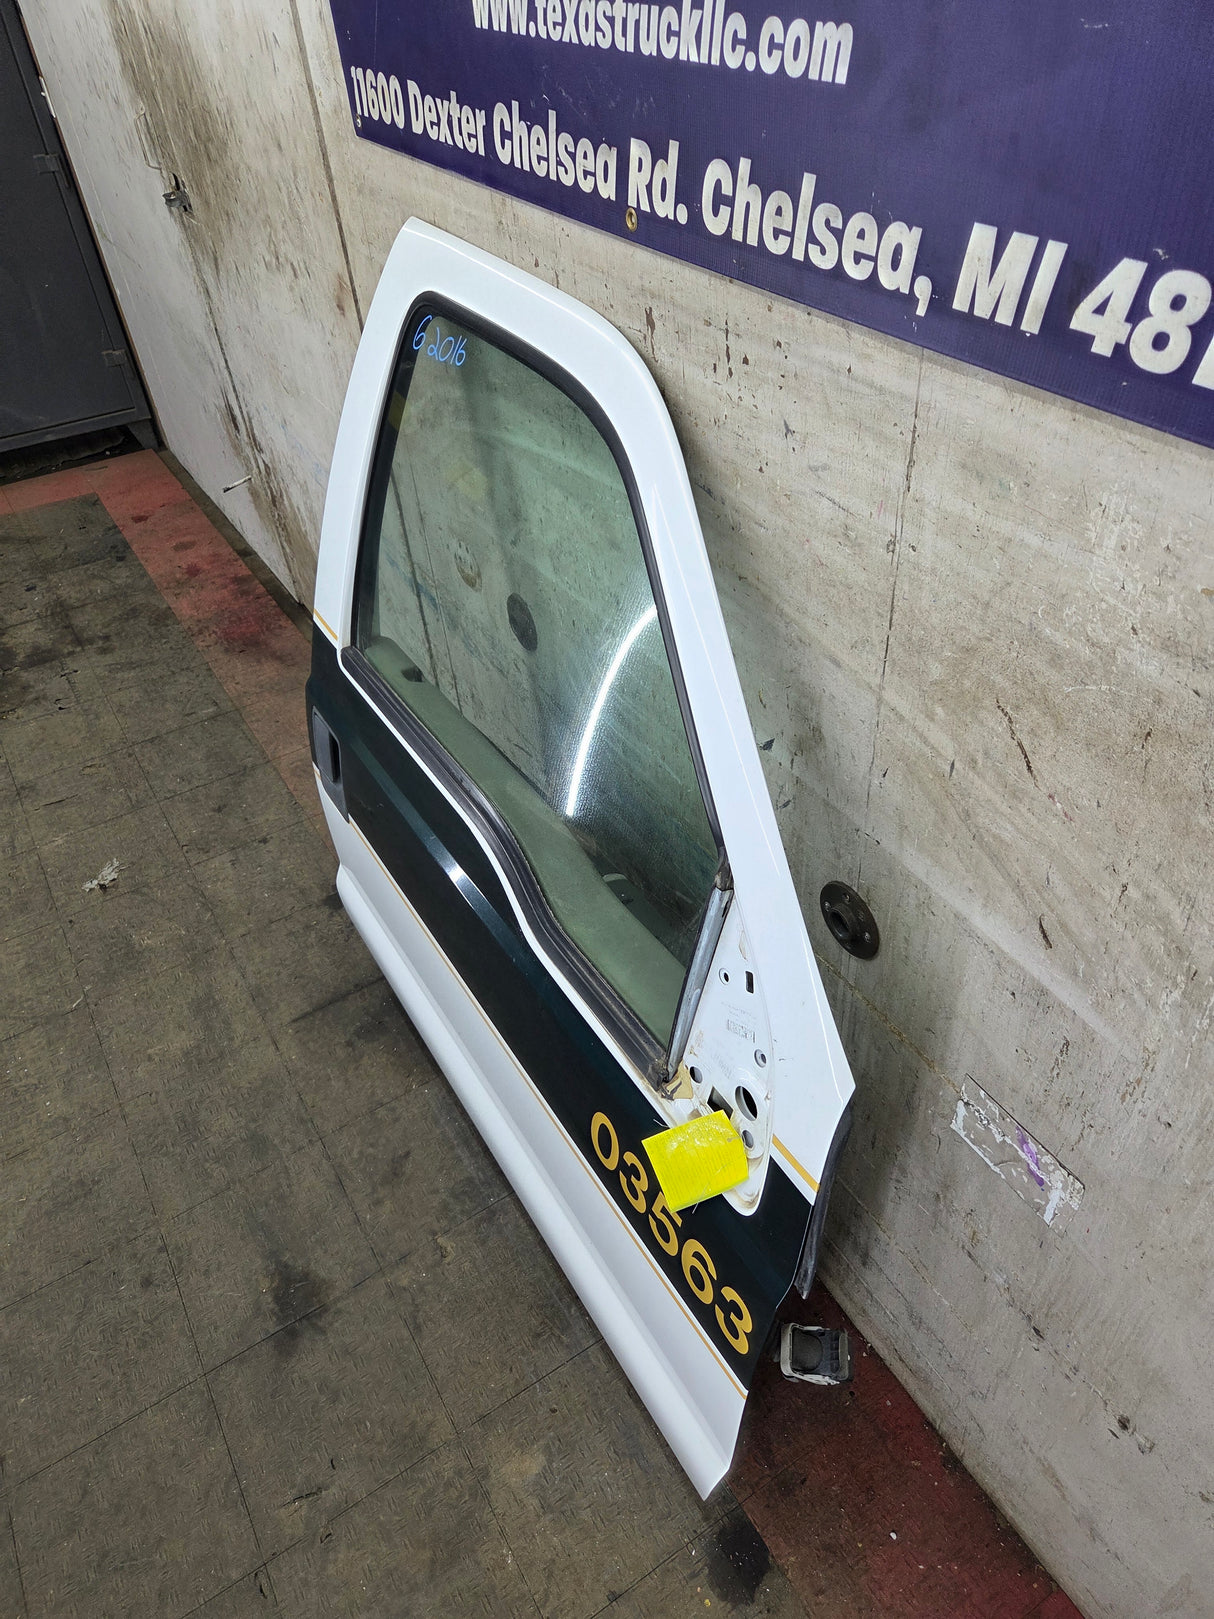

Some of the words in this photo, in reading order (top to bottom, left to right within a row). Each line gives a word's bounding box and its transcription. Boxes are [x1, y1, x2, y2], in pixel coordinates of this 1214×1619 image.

[472, 0, 853, 85] www.texastruckllc.com
[350, 65, 405, 129] 11600
[407, 79, 486, 156] Dexter
[493, 101, 618, 201] Chelsea
[627, 137, 688, 225] Rd.
[701, 156, 933, 317] Chelsea,
[952, 221, 1068, 335] MI
[1069, 257, 1214, 390] 48
[590, 1111, 753, 1355] 03563
